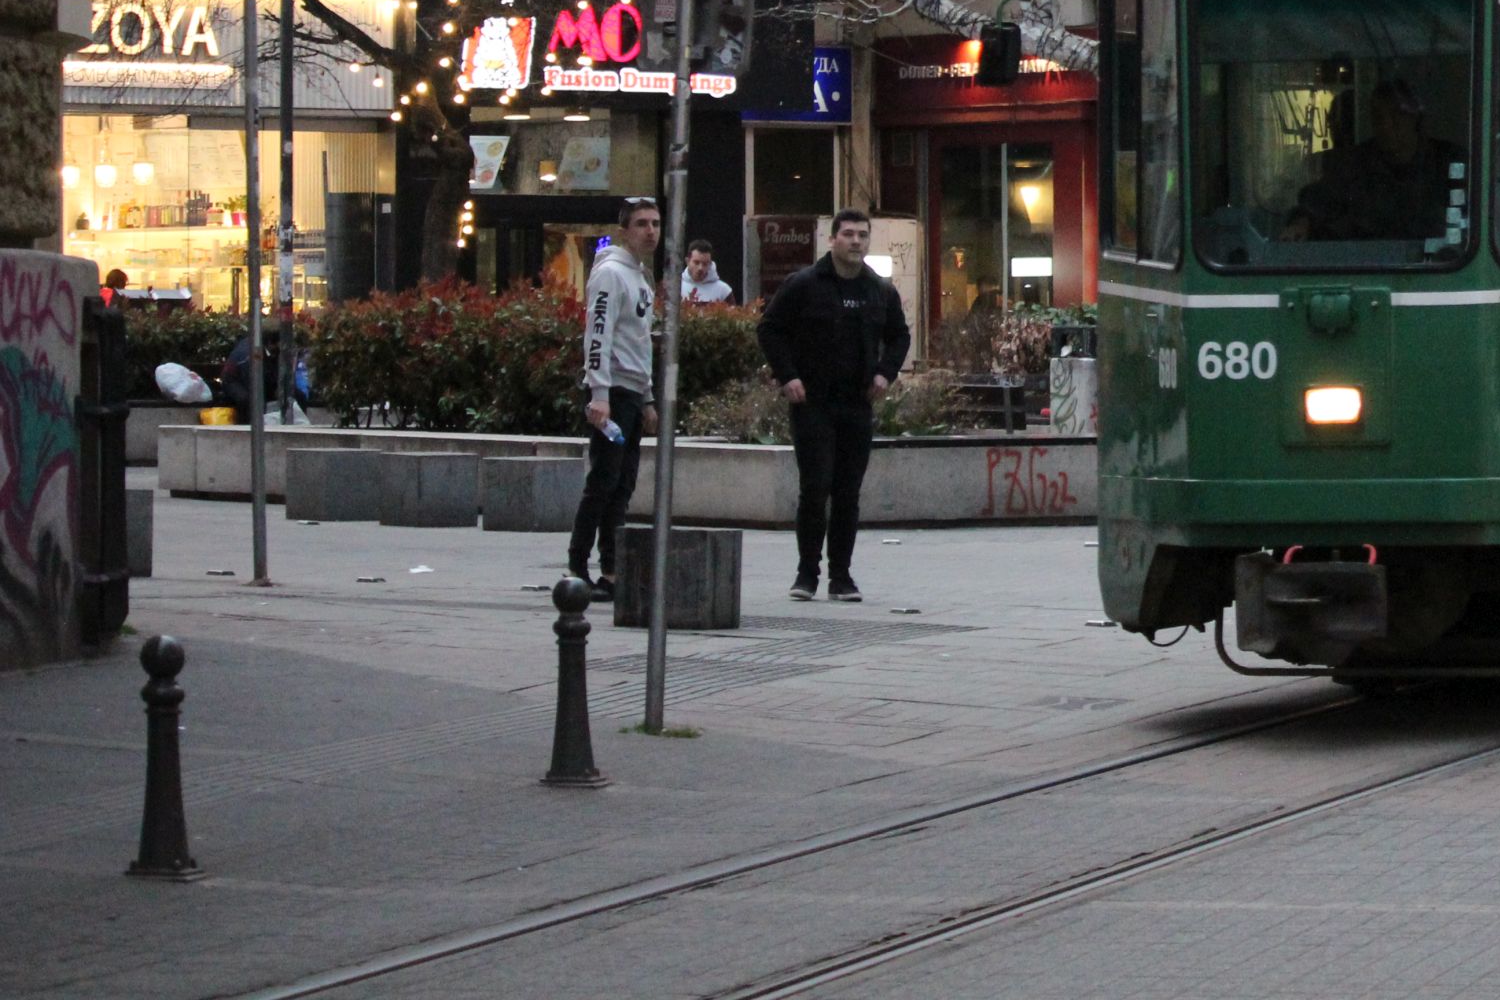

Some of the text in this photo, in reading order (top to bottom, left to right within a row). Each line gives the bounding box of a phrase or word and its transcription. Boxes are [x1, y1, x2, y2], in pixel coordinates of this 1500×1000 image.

[546, 69, 733, 92] Fusion Dumings
[588, 291, 609, 371] NIKE AIR
[1158, 346, 1177, 389] 680
[1198, 341, 1277, 380] 680
